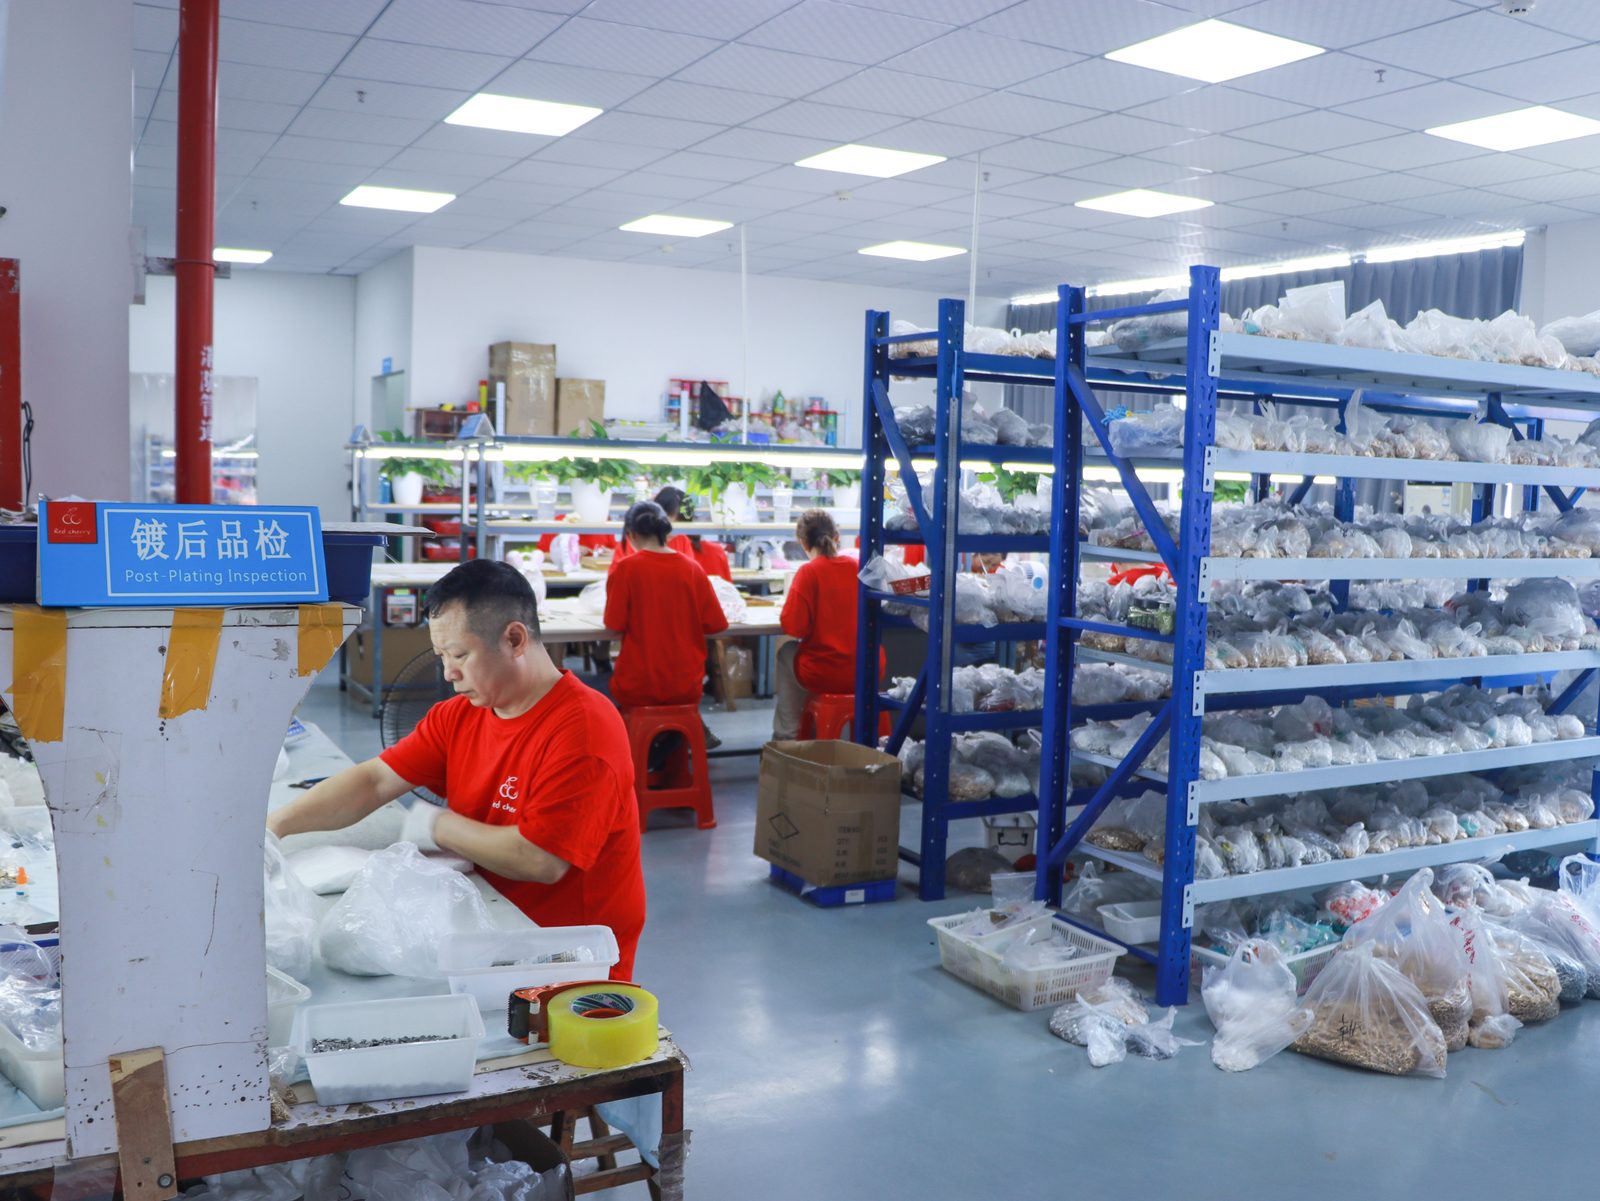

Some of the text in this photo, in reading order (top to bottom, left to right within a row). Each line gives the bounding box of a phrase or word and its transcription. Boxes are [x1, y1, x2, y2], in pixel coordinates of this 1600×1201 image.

[130, 518, 292, 561] 镀后品检
[125, 569, 307, 586] Post-Plating Inspection
